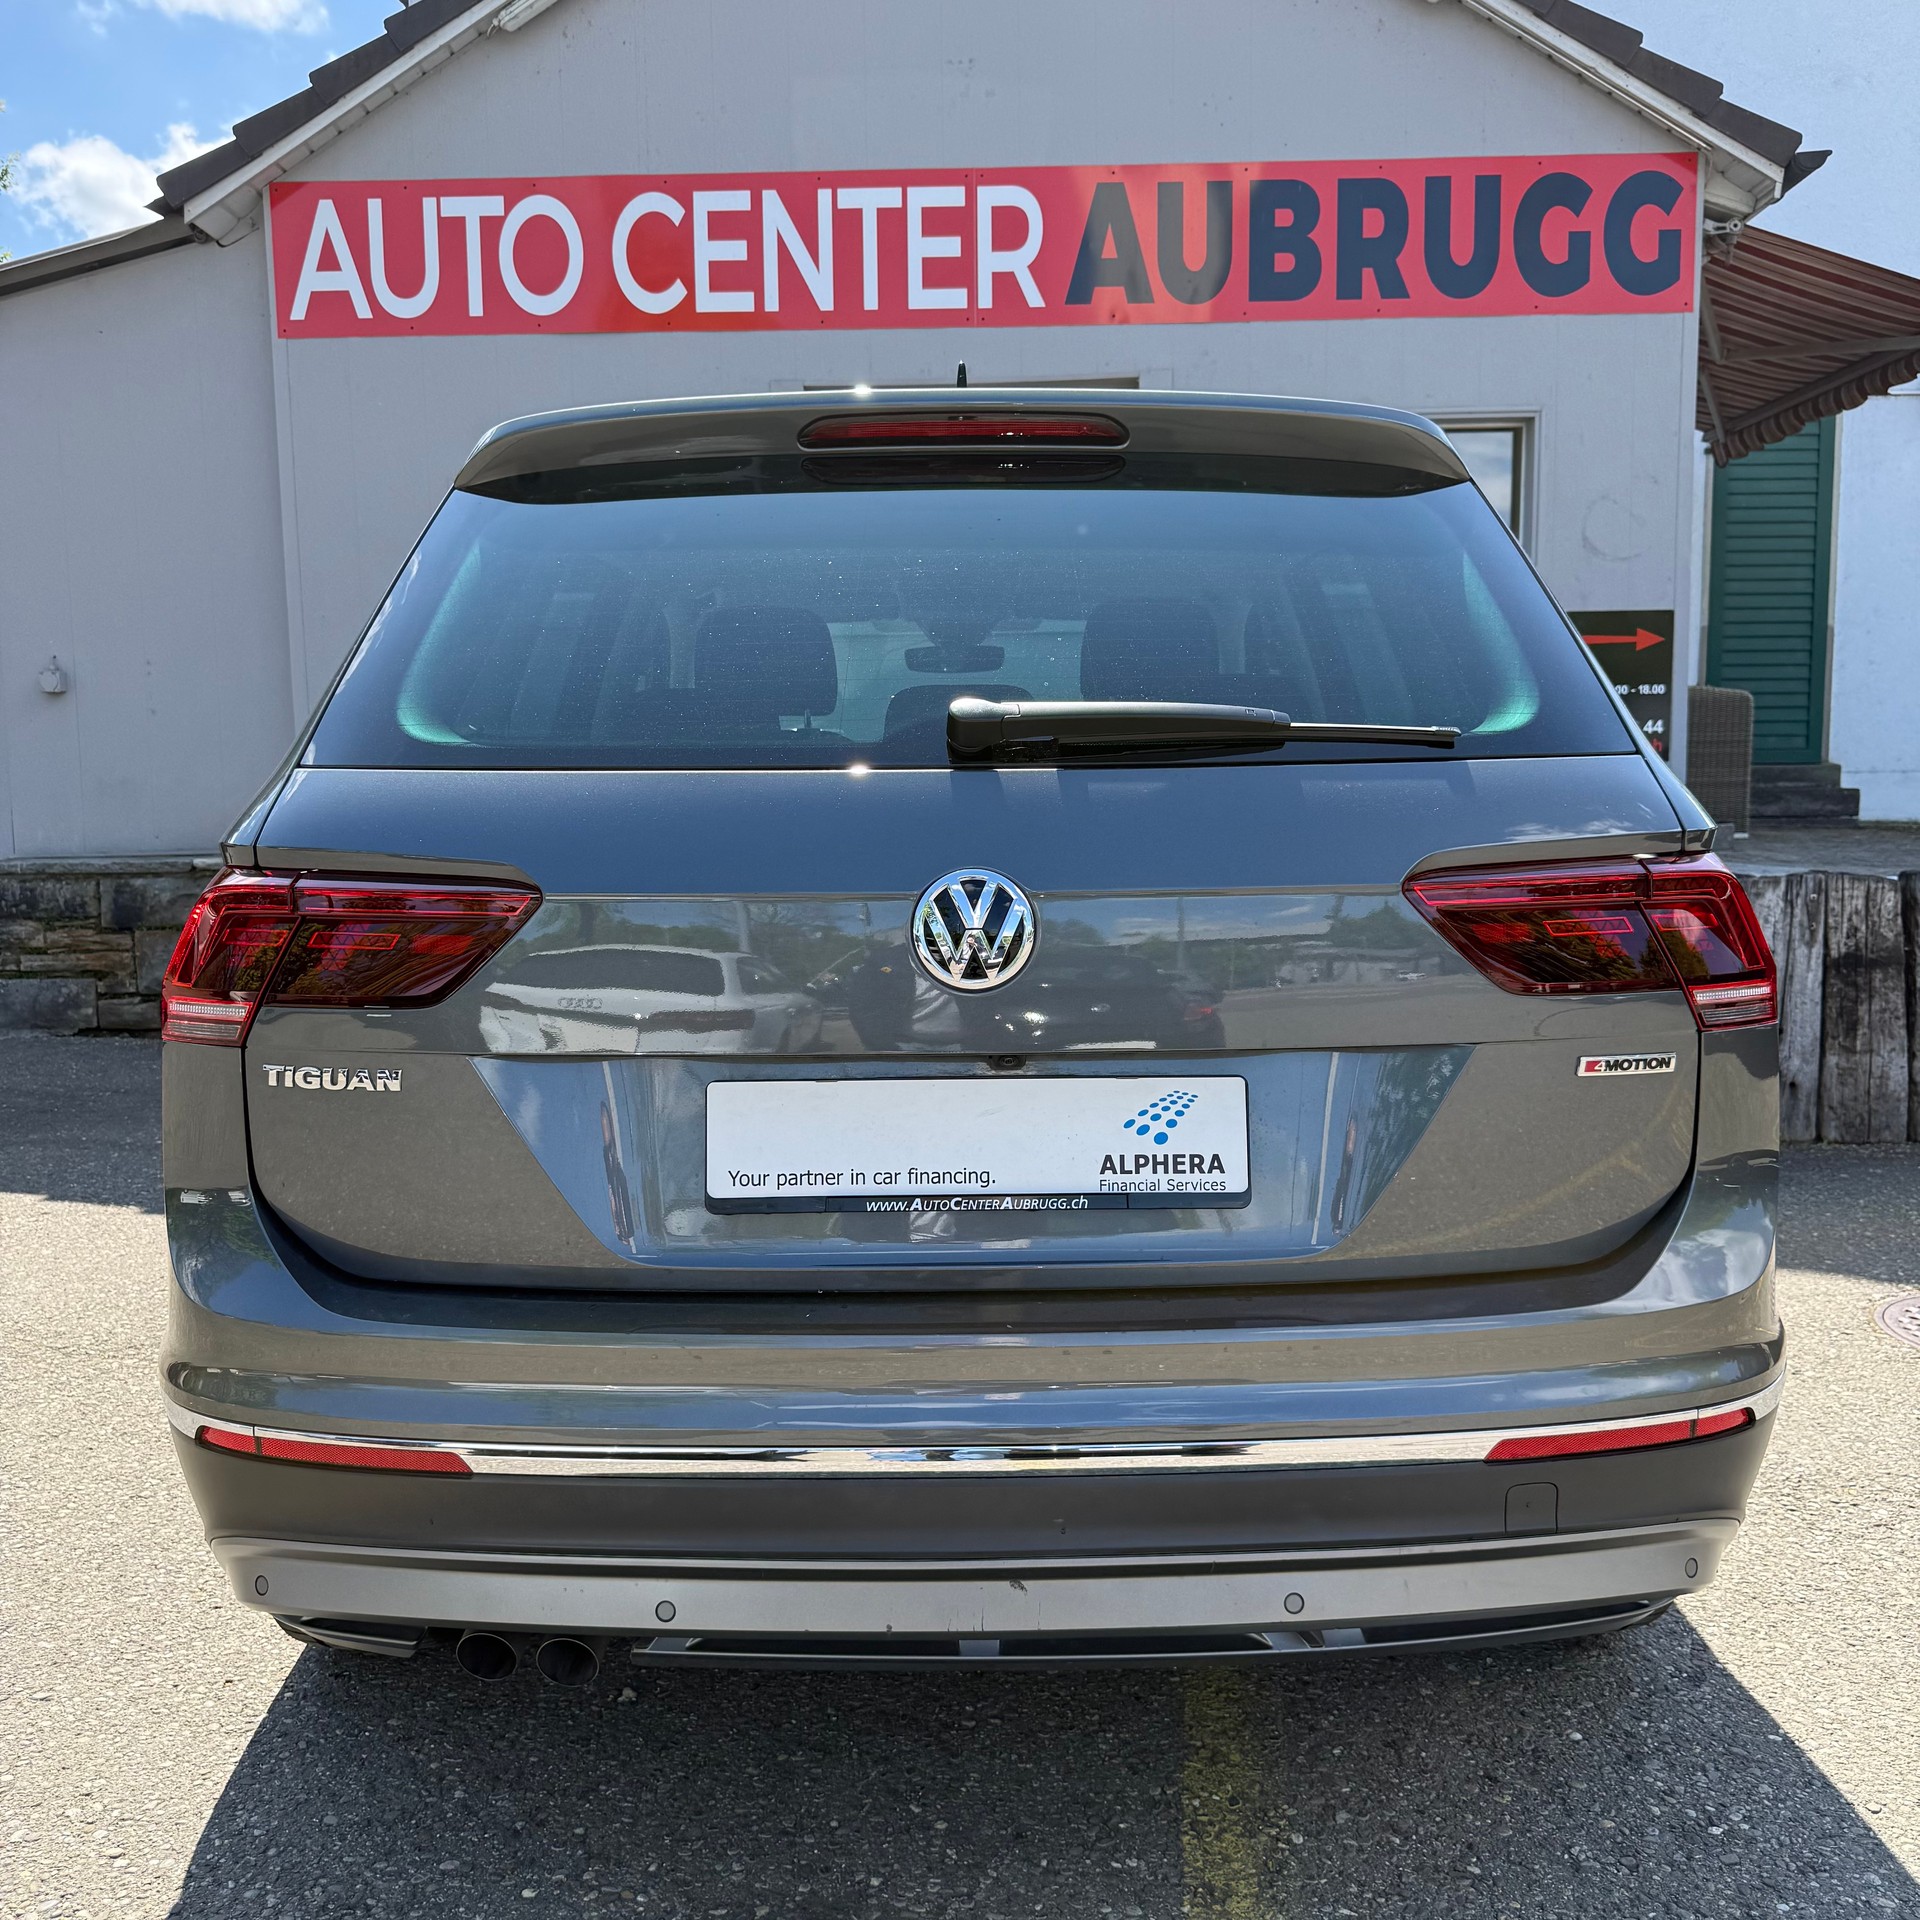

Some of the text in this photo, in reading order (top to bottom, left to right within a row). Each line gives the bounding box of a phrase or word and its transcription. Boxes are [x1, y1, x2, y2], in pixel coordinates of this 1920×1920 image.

[290, 170, 1685, 320] AUTO CENTER AUBRUGG
[1637, 684, 1666, 695] 18.00
[1642, 719, 1664, 734] 44
[262, 1064, 403, 1092] TIGUAN
[1100, 1153, 1226, 1175] ALPHERA
[728, 1167, 996, 1190] Your partner in car financing.
[1099, 1178, 1227, 1192] Financial Services
